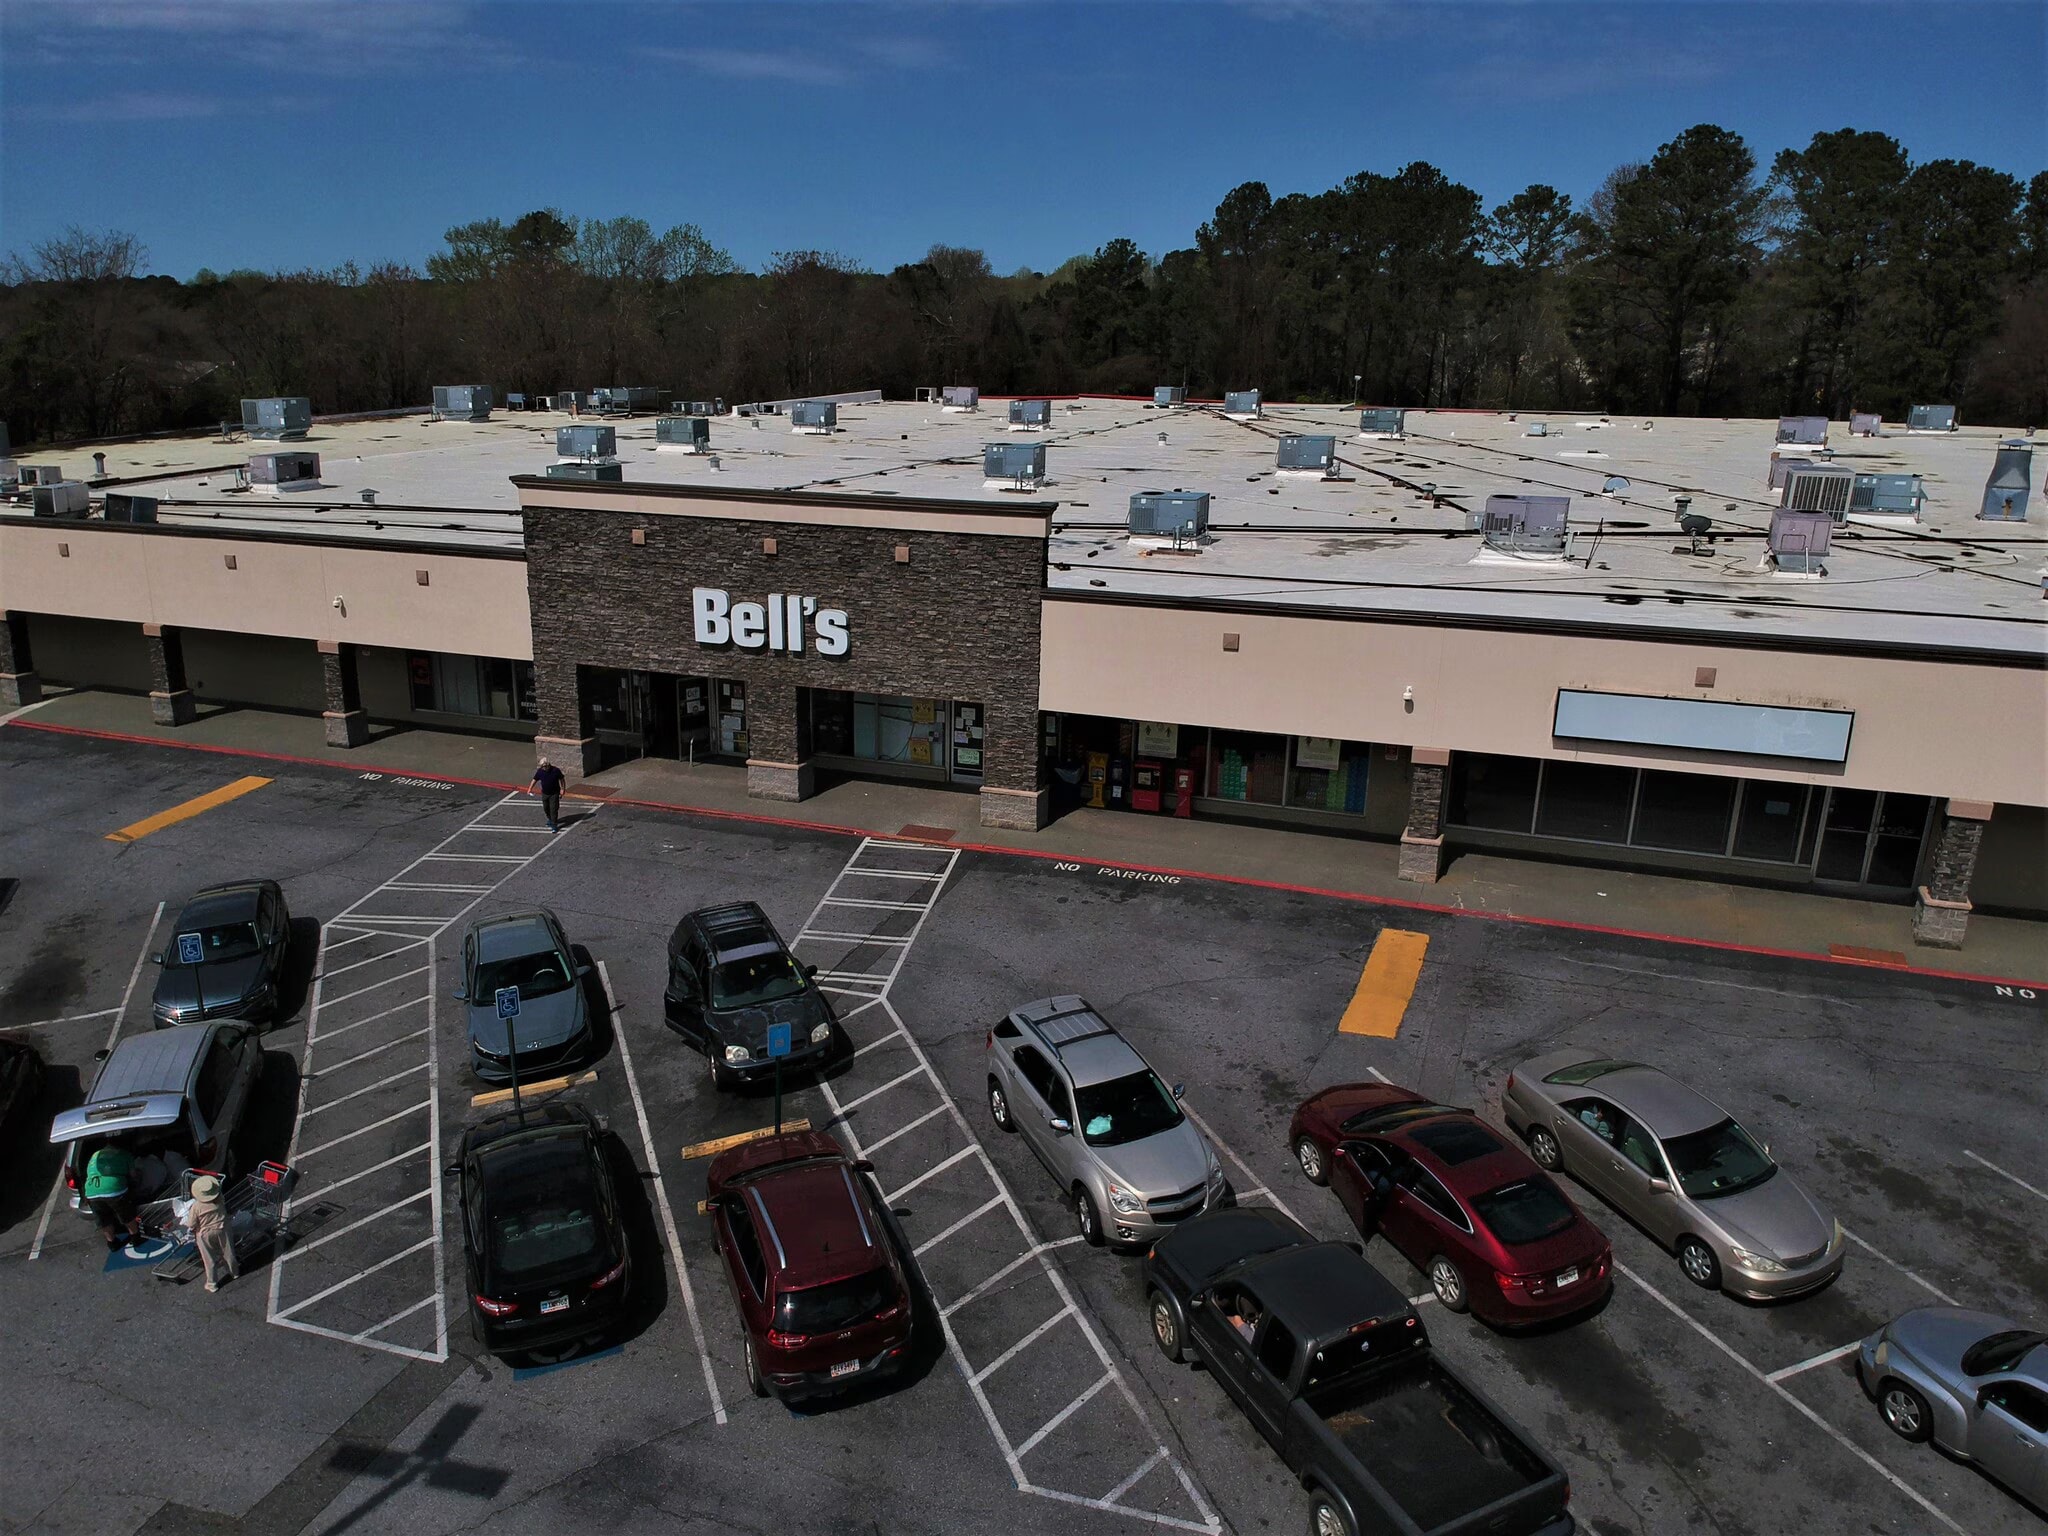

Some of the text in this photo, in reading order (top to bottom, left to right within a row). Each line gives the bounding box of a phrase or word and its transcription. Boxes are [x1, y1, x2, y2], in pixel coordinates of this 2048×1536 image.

[692, 587, 850, 656] Bell's
[358, 772, 455, 791] NO PARKING
[1054, 862, 1181, 884] NO PARKING
[1994, 985, 2036, 999] NO
